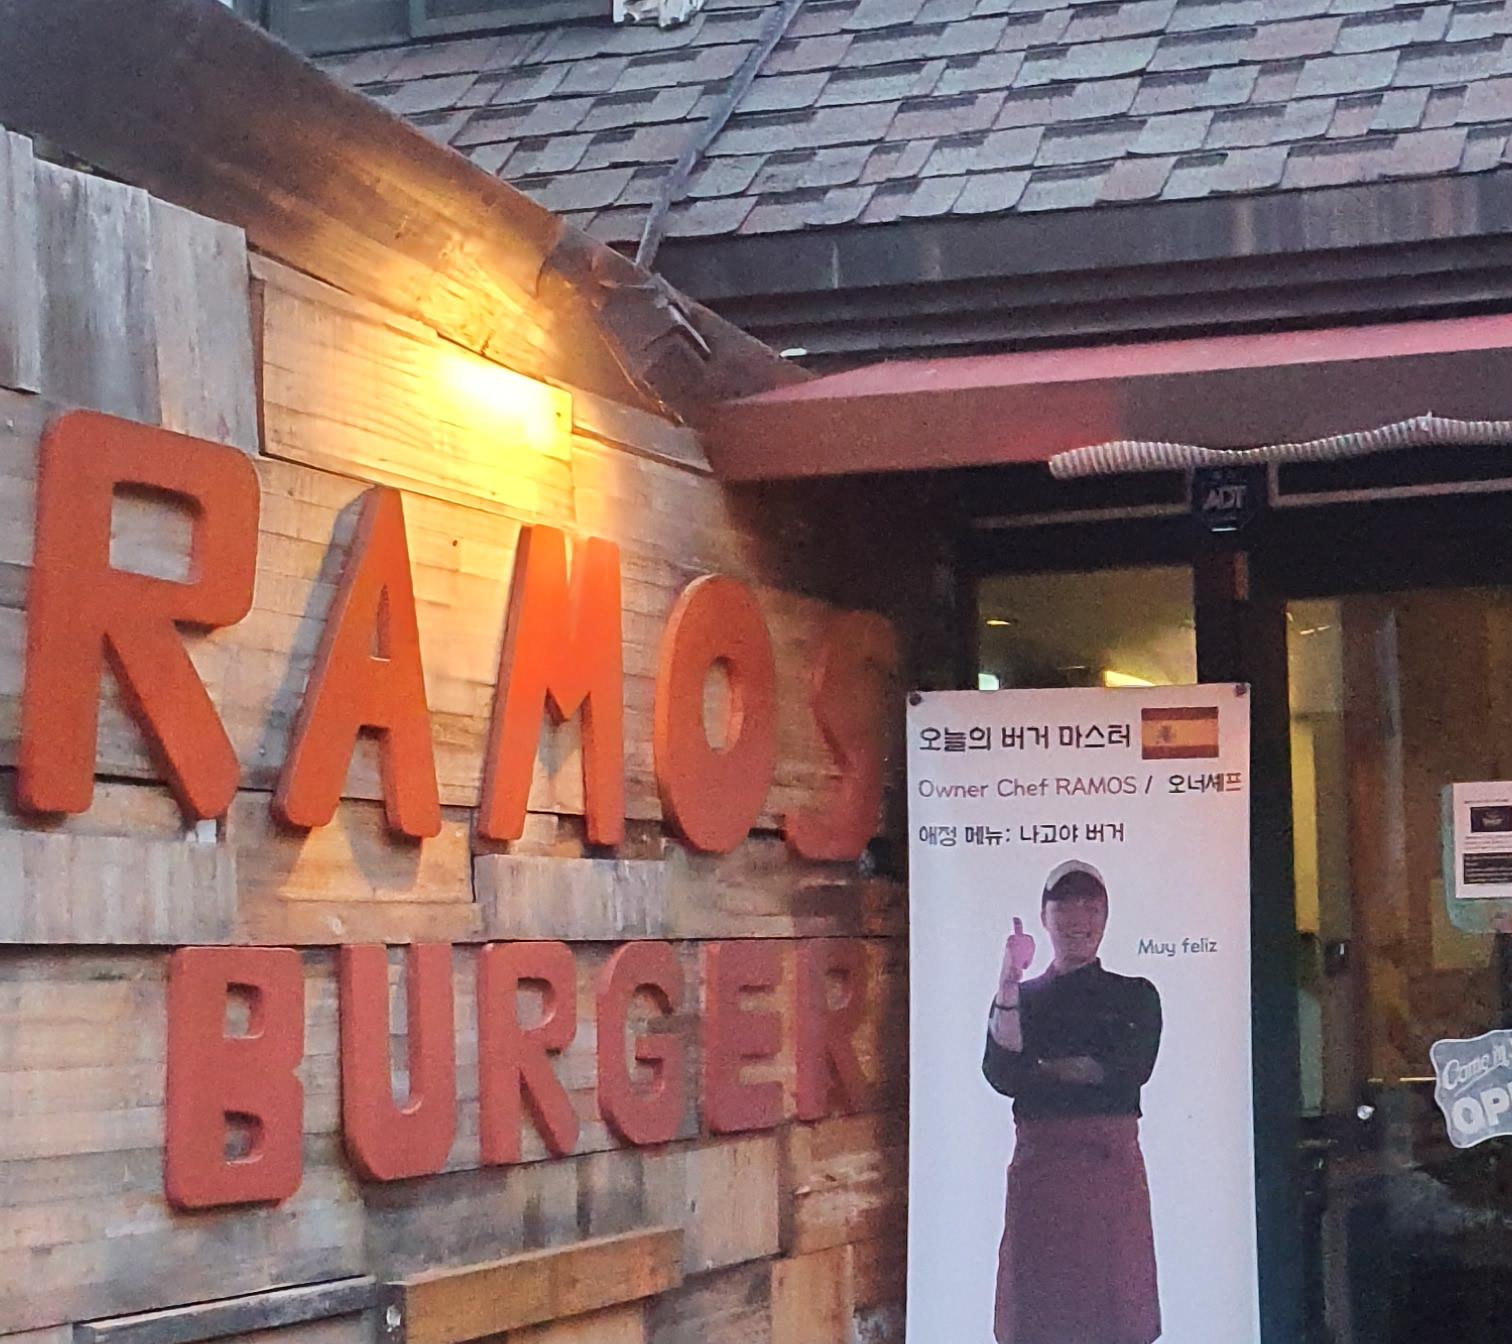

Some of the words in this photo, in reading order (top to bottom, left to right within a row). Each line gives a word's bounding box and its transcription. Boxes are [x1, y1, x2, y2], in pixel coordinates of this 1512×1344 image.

[15, 409, 899, 863] RAMOS
[919, 726, 992, 752] 오늘의
[1001, 725, 1049, 750] 버거
[1059, 724, 1131, 748] 마스터
[919, 779, 988, 798] Owner
[997, 777, 1048, 797] Chef
[1055, 776, 1137, 796] RAMOS
[919, 825, 957, 847] 애정
[965, 824, 1010, 846] 메뉴:
[1019, 824, 1078, 845] 나고야
[1086, 823, 1124, 843] 버거
[1138, 938, 1176, 957] Muy
[1182, 937, 1217, 953] feliz
[165, 941, 879, 1209] BURGER
[1442, 1053, 1491, 1091] Come
